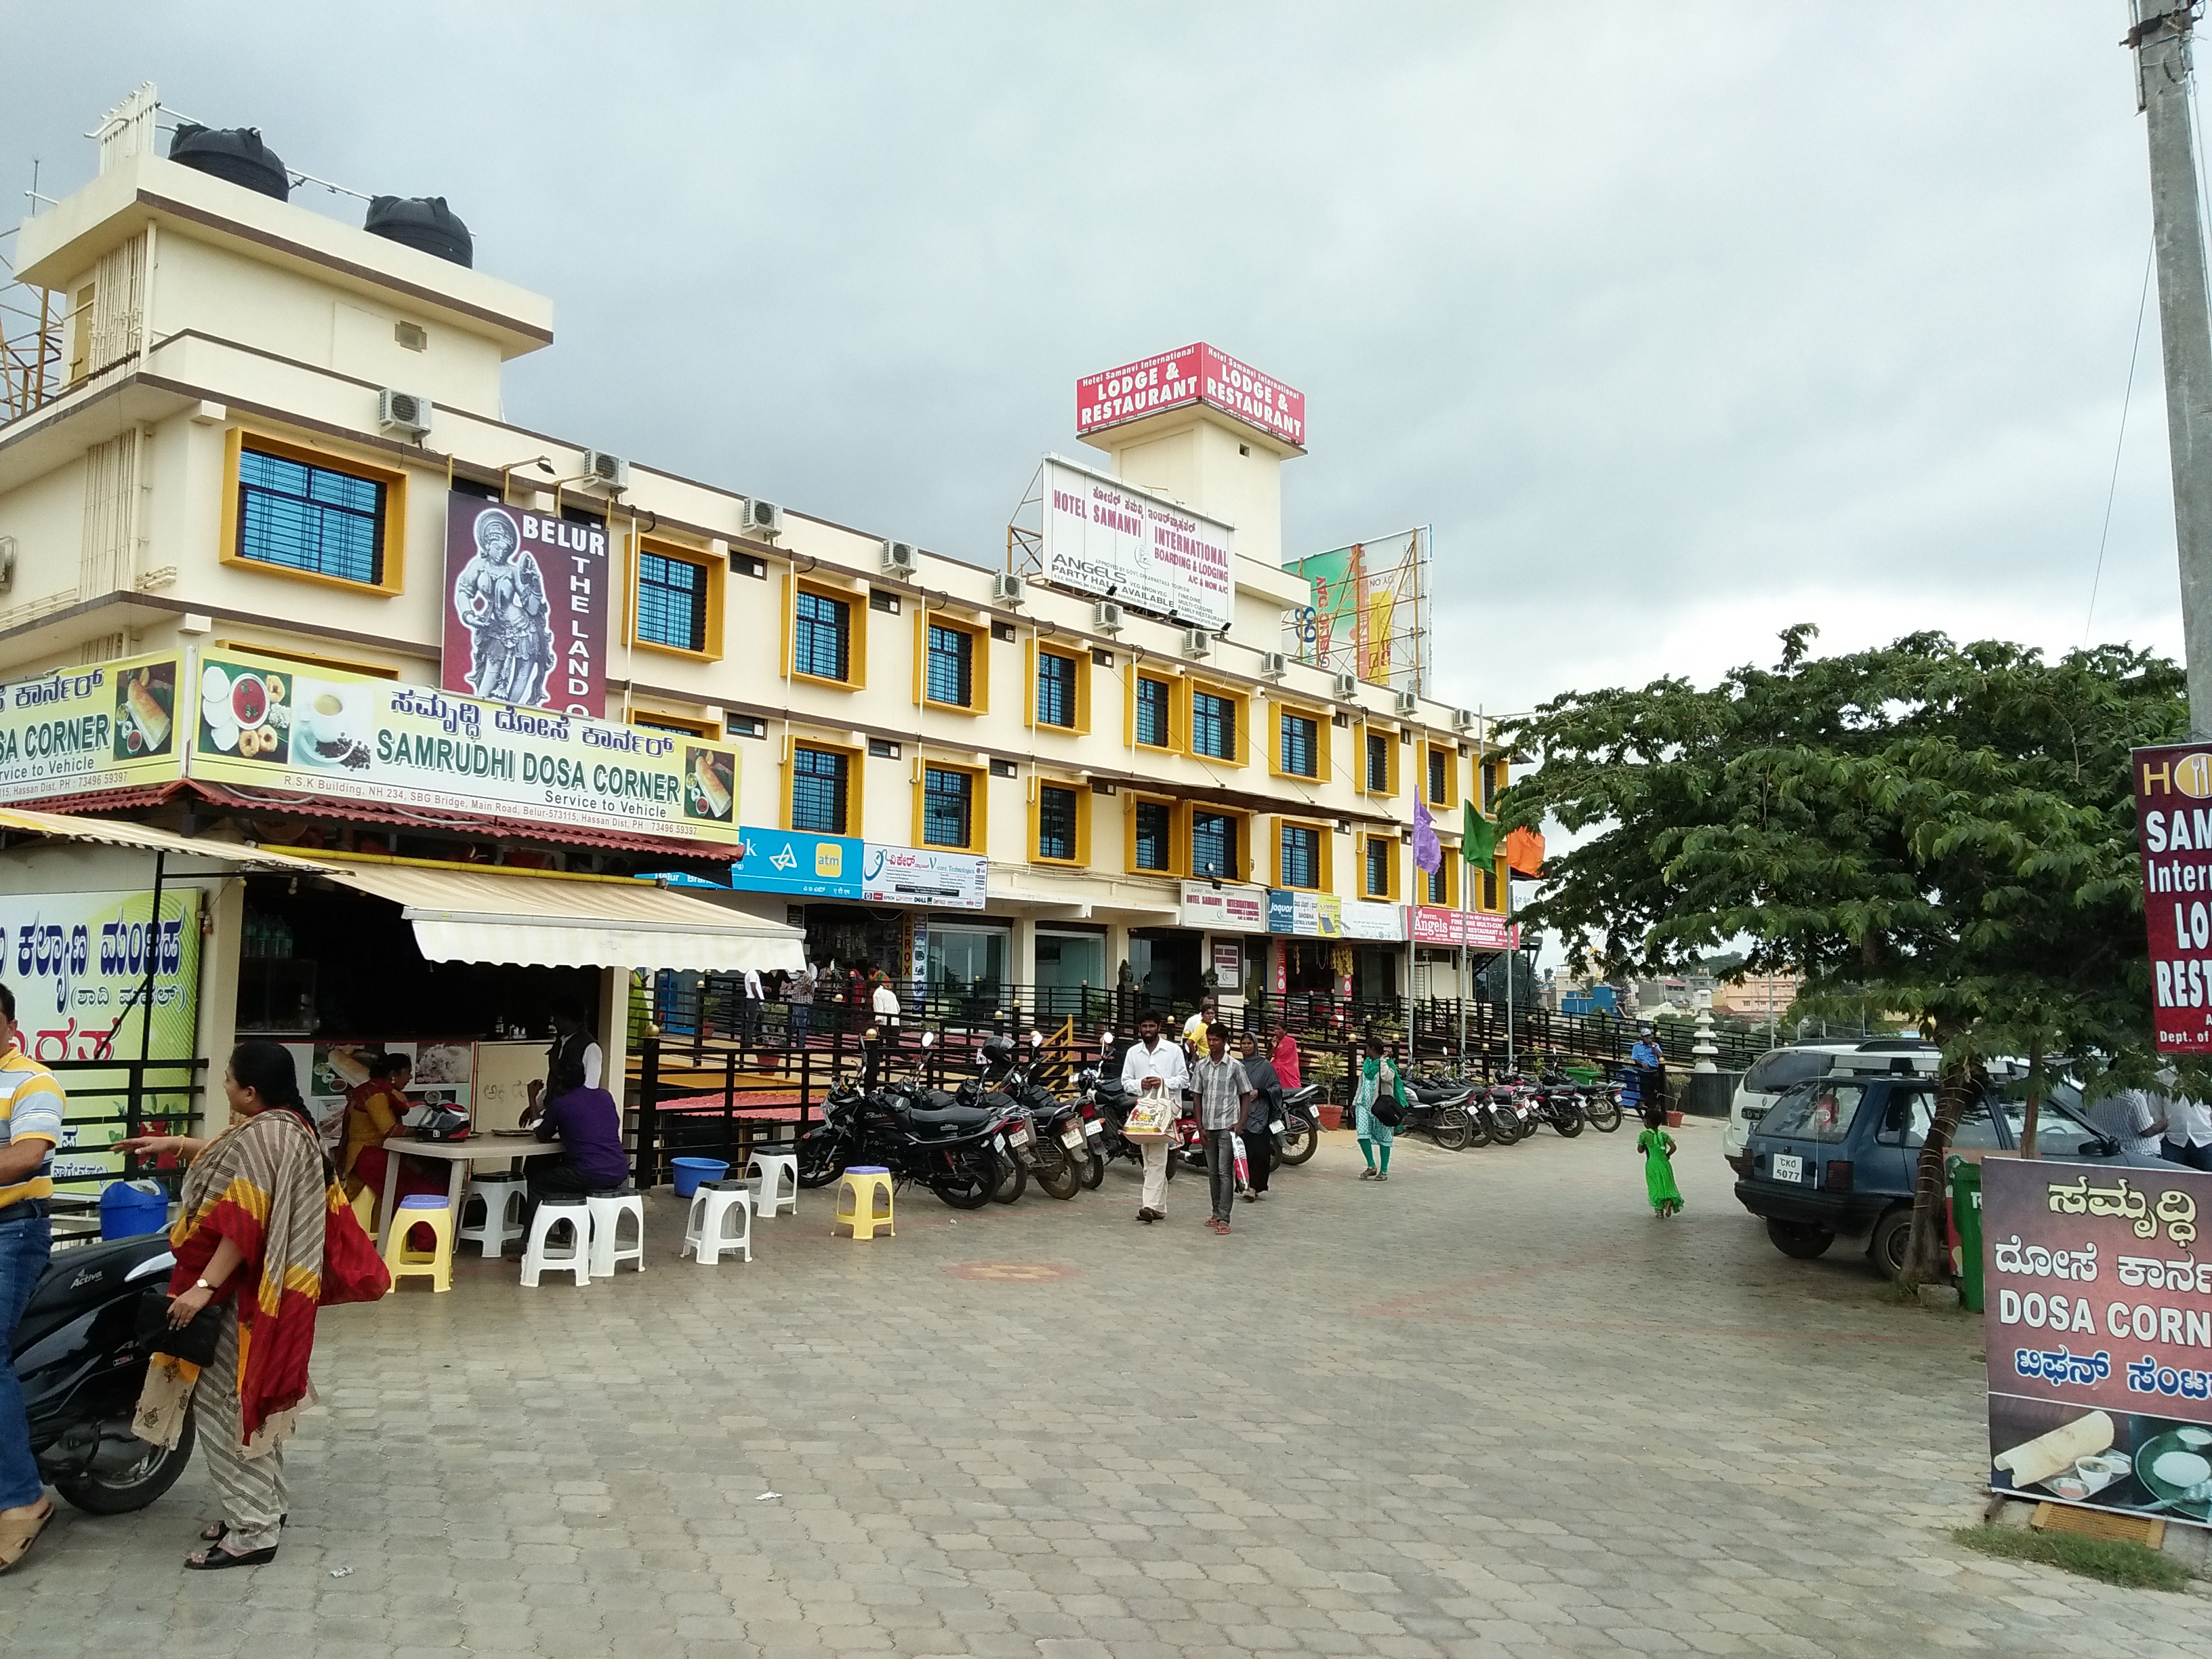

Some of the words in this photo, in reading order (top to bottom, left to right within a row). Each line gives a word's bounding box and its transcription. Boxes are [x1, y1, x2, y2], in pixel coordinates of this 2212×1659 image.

[1082, 375, 1103, 387] Hotel
[1105, 365, 1139, 380] Samanvi
[1141, 346, 1195, 369] International
[1098, 367, 1158, 401] LODGE
[1166, 362, 1180, 380] &
[1208, 347, 1227, 363] Hotel
[1229, 357, 1256, 380] Samanvi
[1258, 372, 1299, 400] International
[1082, 375, 1198, 426] RESTAURANT
[1206, 376, 1301, 437] RESTAURANT
[1221, 364, 1273, 404] LODGE
[1277, 393, 1289, 413] &
[523, 514, 605, 556] BELUR
[1054, 489, 1087, 519] HOTEL
[1093, 504, 1141, 537] SAMANVI
[1154, 526, 1228, 568] INTERNATIONAL
[569, 555, 591, 614] THE
[1052, 553, 1127, 584] ANGELS
[1052, 564, 1088, 581] PARTY
[1122, 586, 1174, 608] AVAILABLE
[1154, 547, 1191, 571] BOARDING
[1192, 560, 1197, 573] &
[1198, 562, 1228, 583] LODGING
[1188, 574, 1199, 585] A/C
[1195, 611, 1227, 623] RESTAURANT
[567, 619, 590, 696] LAND
[15, 668, 104, 708] ಕಾರ್ನರ್
[24, 713, 110, 759] CORNER
[390, 689, 481, 739] ಸಮೃದ್ಧಿ
[494, 705, 570, 741] ದೋಸೆ
[581, 725, 674, 757] ಕಾರ್ನರ್
[14, 784, 39, 796] Hassan
[60, 778, 70, 790] PH
[79, 775, 102, 787] 73496
[104, 771, 128, 784] 59397
[32, 763, 44, 777] to
[49, 756, 94, 775] Vehicle
[375, 728, 516, 781] SAMRUDHI
[523, 751, 587, 791] DOSA
[593, 763, 682, 804] CORNER
[318, 778, 365, 796] Building,
[369, 787, 384, 798] NH
[386, 789, 407, 801] 234,
[410, 792, 432, 803] SBG
[434, 794, 468, 809] Bridge,
[471, 799, 493, 811] Main
[495, 802, 520, 815] Road,
[581, 813, 610, 826] Hassan
[613, 817, 630, 829] Dist,
[632, 820, 643, 830] PH
[651, 822, 674, 834] 73496
[676, 824, 698, 836] 59397
[544, 790, 597, 809] Service
[602, 798, 615, 812] to
[620, 800, 667, 818] Vehicle
[818, 855, 840, 866] atm
[903, 912, 912, 976] XEROX
[1414, 916, 1448, 935] Angels
[1467, 927, 1498, 935] RESTAURANT
[2159, 1030, 2192, 1044] Dept.
[2197, 1030, 2209, 1042] of
[1776, 1169, 1800, 1180] 5077
[2047, 1174, 2198, 1249] ಸಮೃದ್ಧಿ
[1994, 1233, 2099, 1282] ದೋಸೆ
[1999, 1289, 2097, 1335] DOSA
[2107, 1301, 2212, 1348] CORN
[2015, 1344, 2111, 1387] ಟಿಫನ್
